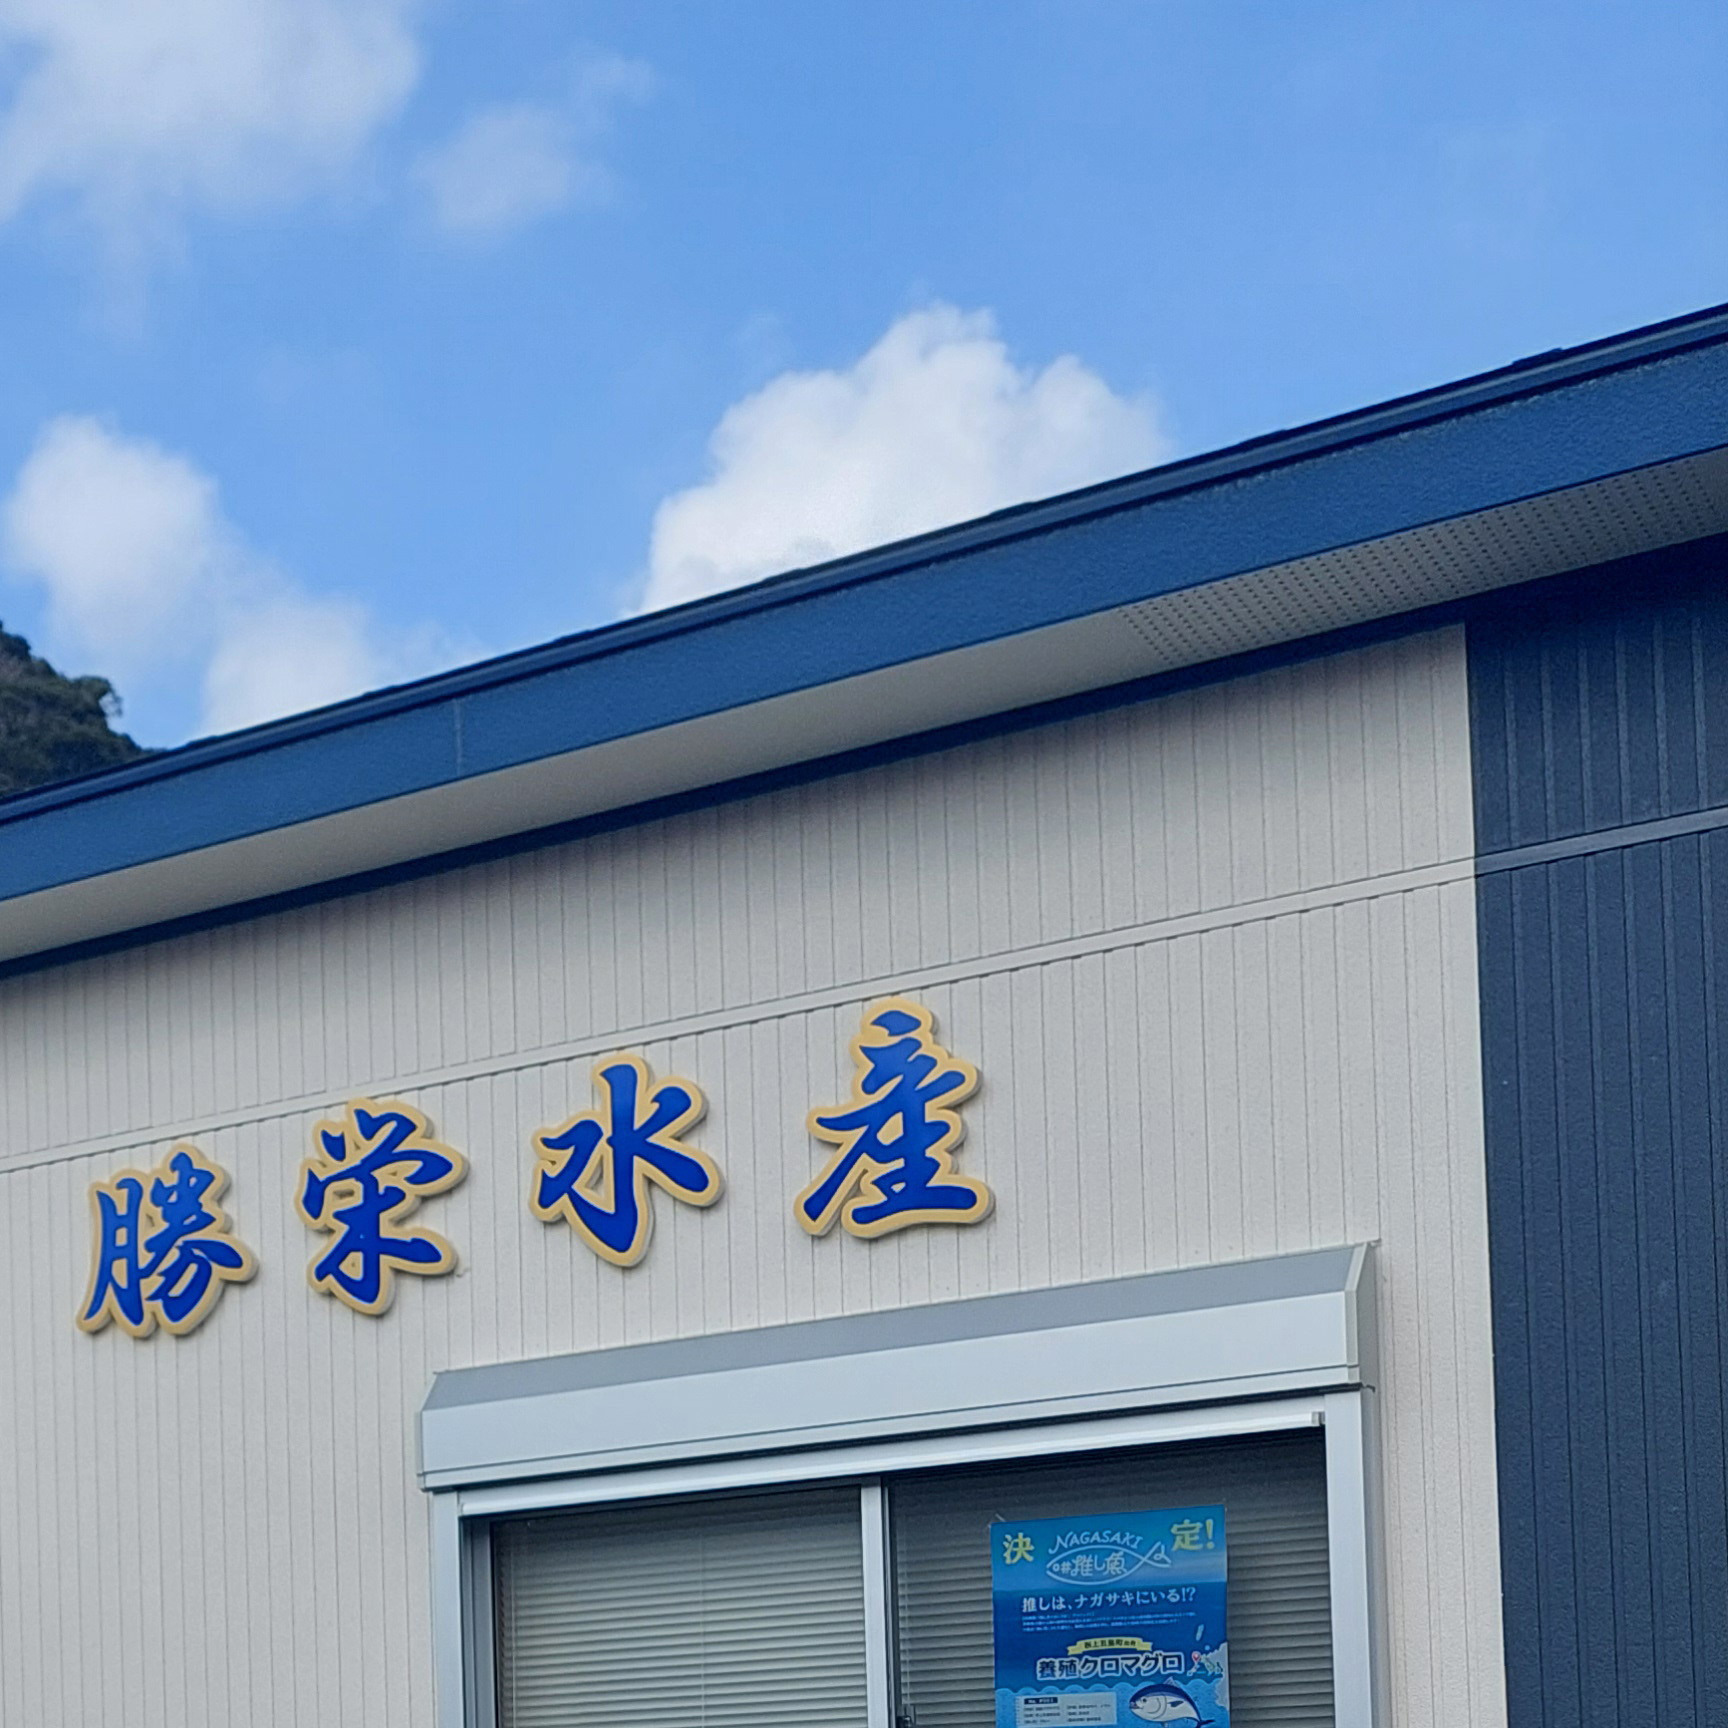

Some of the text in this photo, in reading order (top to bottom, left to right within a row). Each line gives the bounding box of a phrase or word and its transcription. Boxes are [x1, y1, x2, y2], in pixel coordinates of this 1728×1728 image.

[78, 1000, 993, 1337] 勝栄水産
[1003, 1532, 1034, 1564] 決
[1048, 1530, 1143, 1554] NAGASAKI
[1037, 1652, 1185, 1680] 養殖クロマグロ
